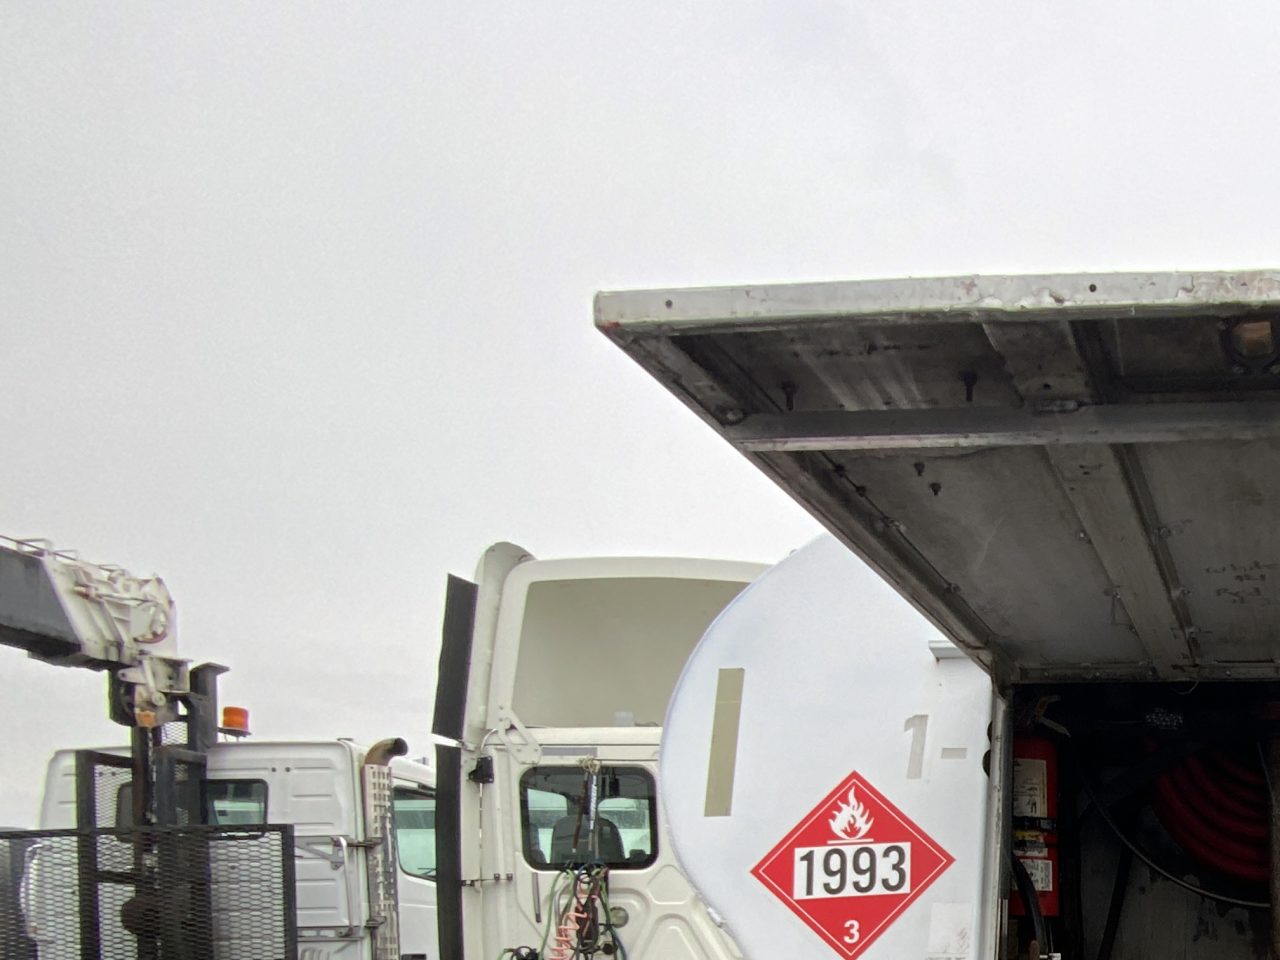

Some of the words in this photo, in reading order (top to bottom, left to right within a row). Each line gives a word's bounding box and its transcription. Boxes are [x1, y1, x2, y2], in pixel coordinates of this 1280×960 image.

[903, 714, 992, 779] 1-
[799, 845, 907, 896] 1993
[843, 919, 860, 944] 3
